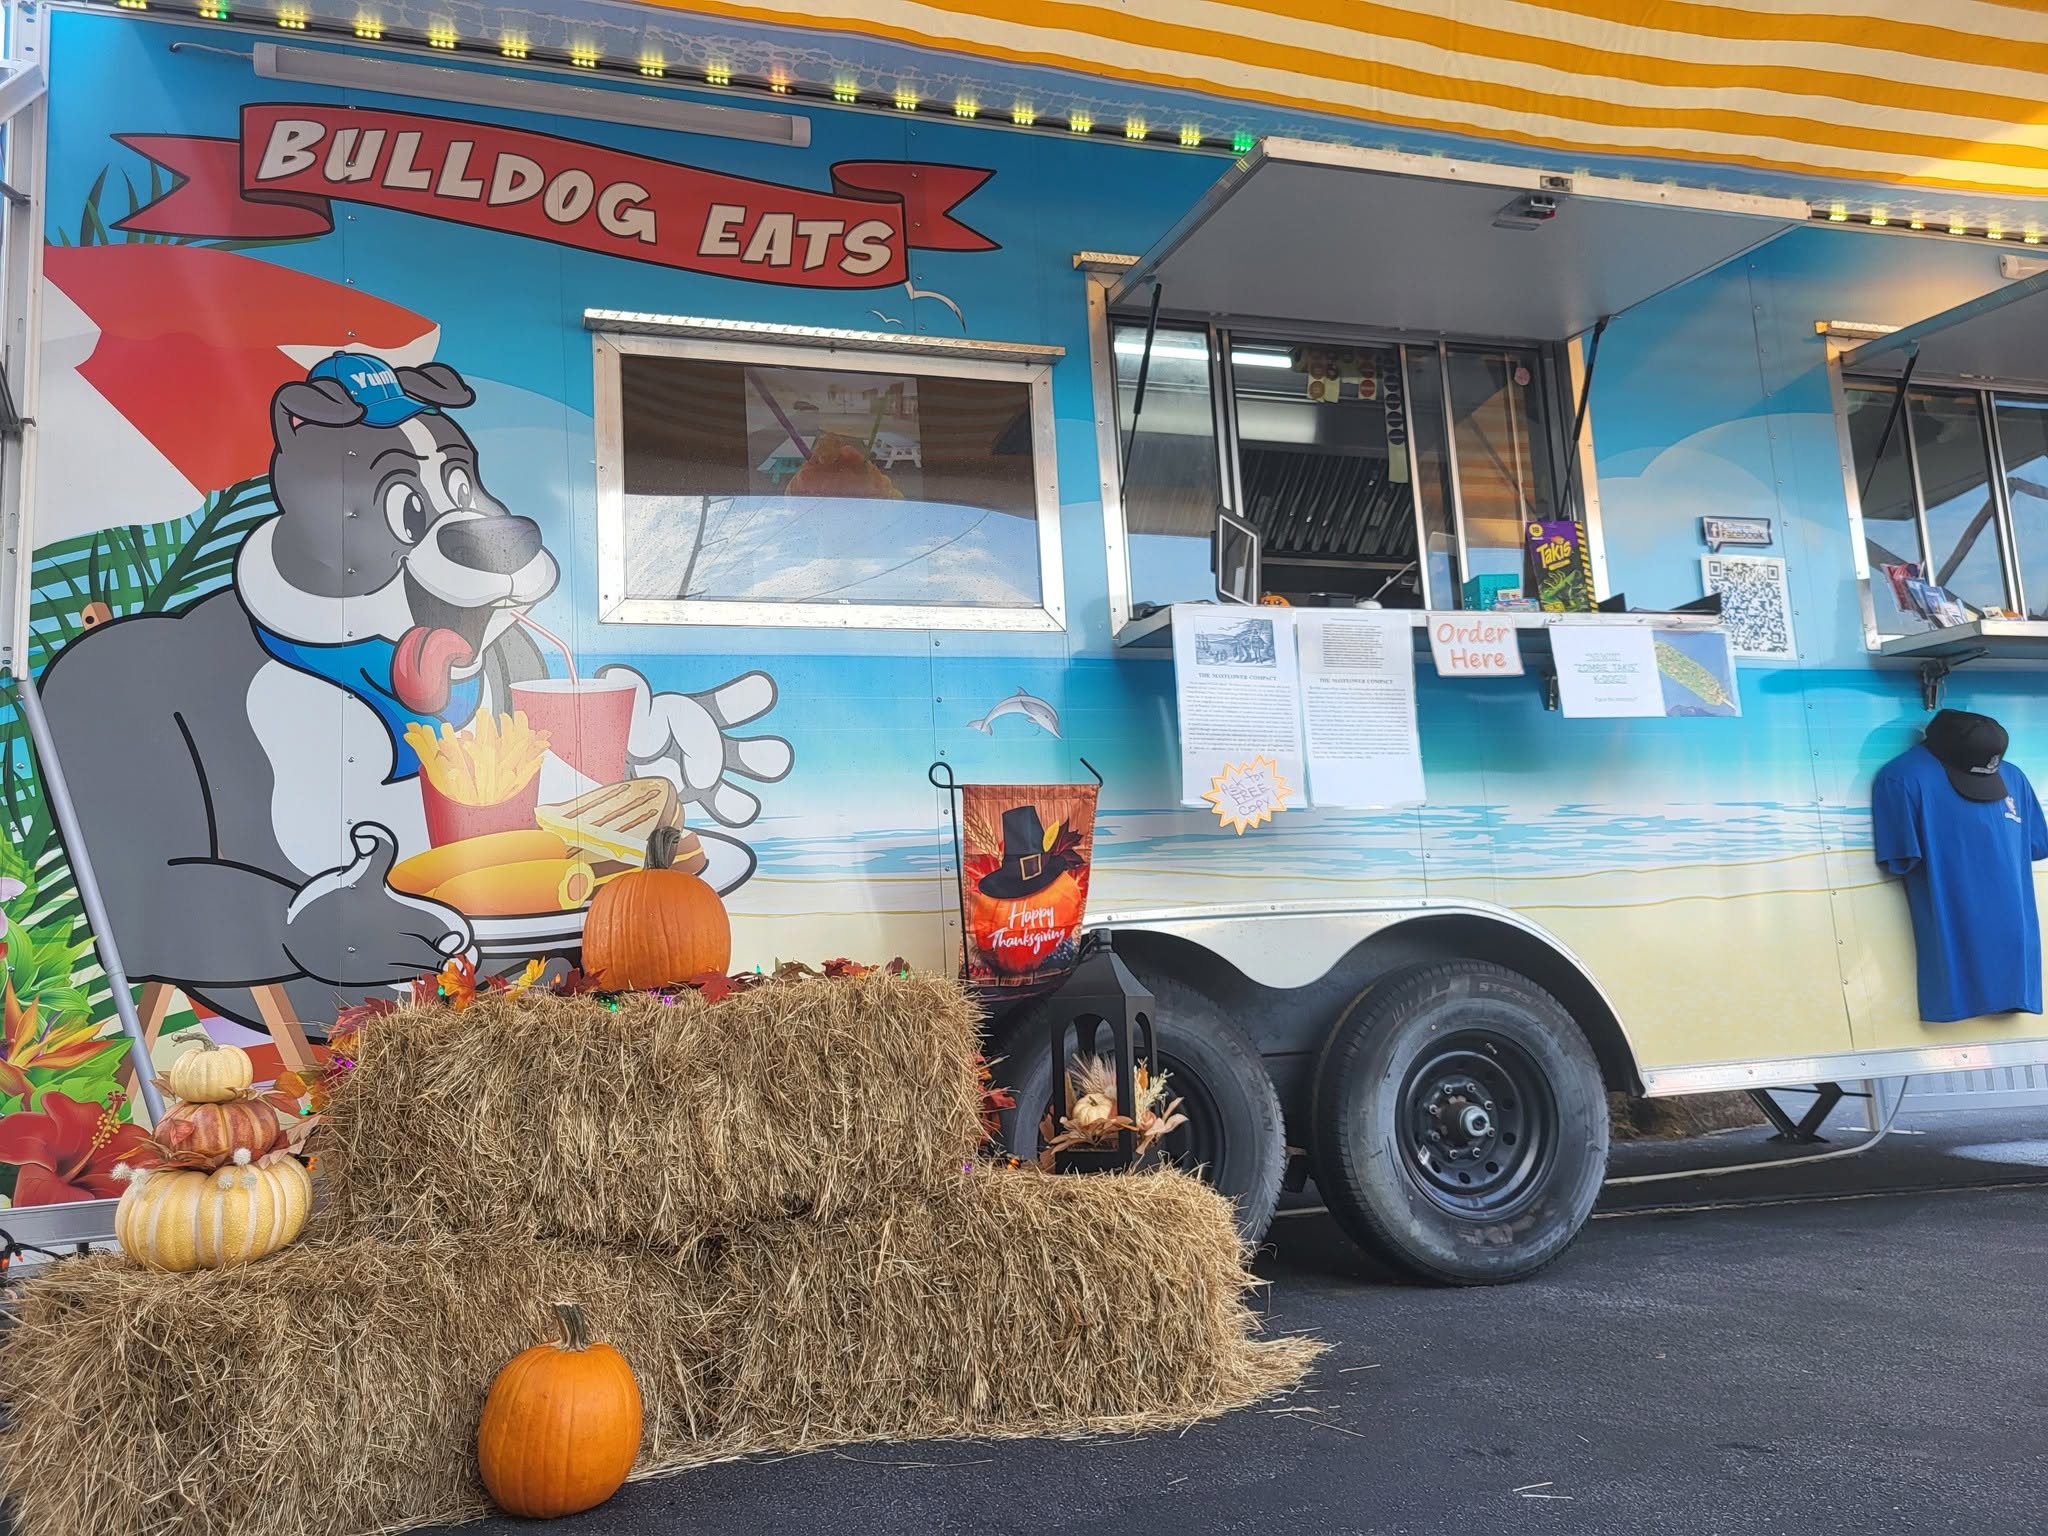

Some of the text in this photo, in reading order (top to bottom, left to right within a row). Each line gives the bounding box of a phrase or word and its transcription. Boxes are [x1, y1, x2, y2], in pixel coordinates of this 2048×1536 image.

[255, 118, 896, 276] BULLDOG EATS
[1536, 540, 1572, 569] Takis
[1436, 620, 1510, 644] Order
[1449, 647, 1507, 669] Here
[1230, 783, 1270, 806] FREE
[1008, 900, 1055, 929] Happy
[987, 926, 1065, 955] Thanksgiving
